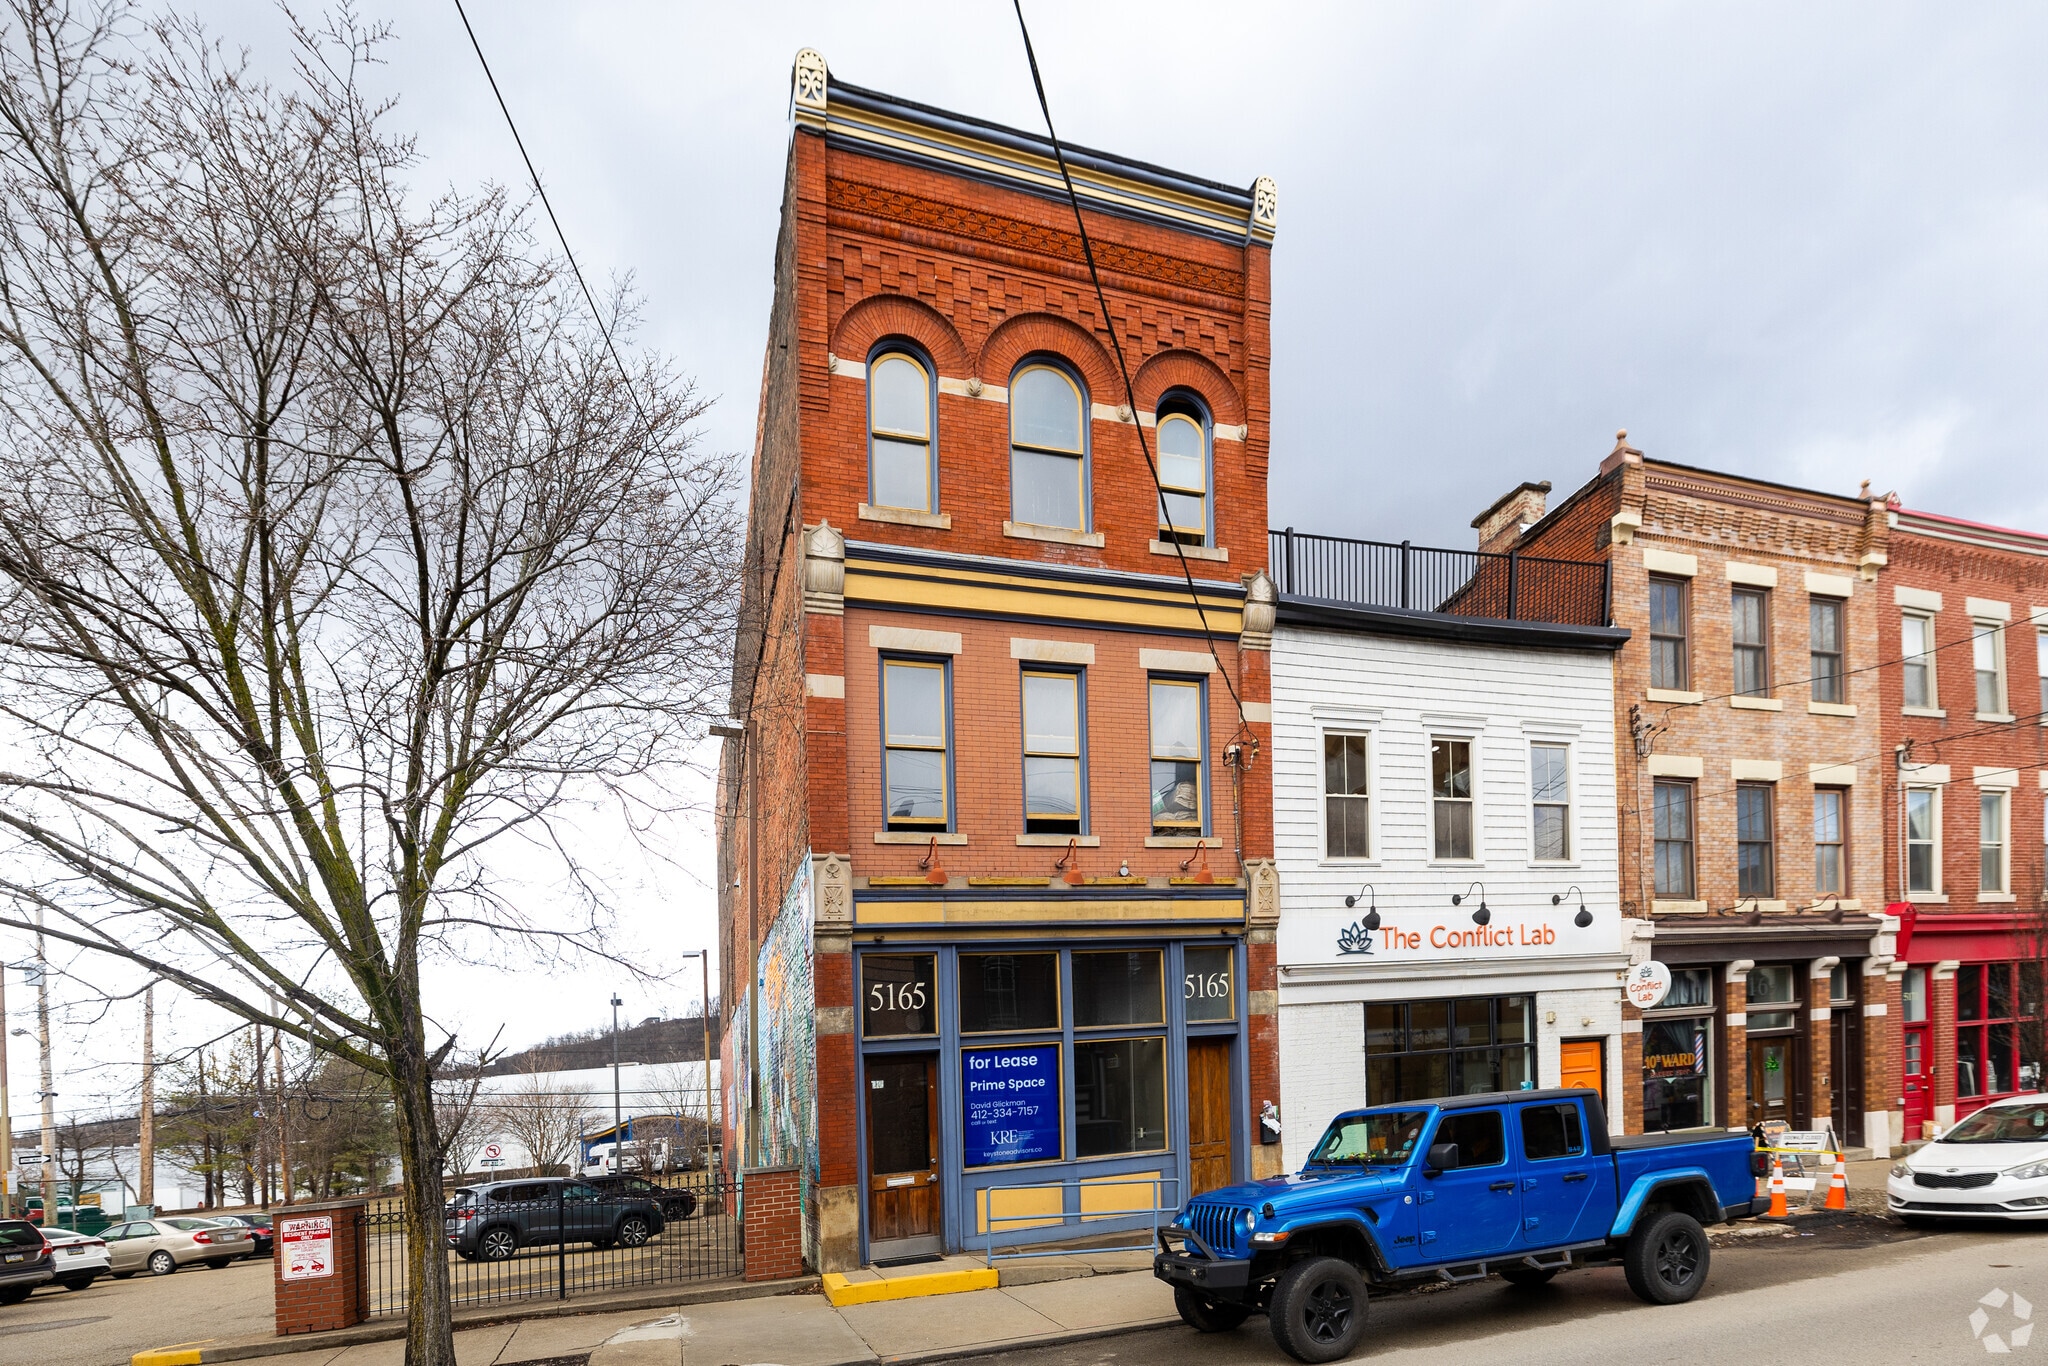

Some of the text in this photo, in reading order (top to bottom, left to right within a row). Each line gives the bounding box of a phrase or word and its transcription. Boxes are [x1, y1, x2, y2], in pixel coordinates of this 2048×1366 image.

[1379, 923, 1556, 950] The Conflict Lab
[1184, 972, 1229, 999] 5165
[1630, 981, 1663, 993] Conflict
[870, 981, 926, 1012] 5165
[1637, 992, 1654, 1002] Lab
[969, 1055, 1038, 1070] for Lease
[1661, 1053, 1696, 1068] WARD
[970, 1079, 1046, 1092] Prime Space
[970, 1100, 1026, 1110] David Glickman
[970, 1105, 1039, 1120] 412-334-7157
[990, 1129, 1019, 1146] KRE
[983, 1147, 1043, 1158] keystoneadvisors.co
[1393, 1235, 1416, 1245] Jeep
